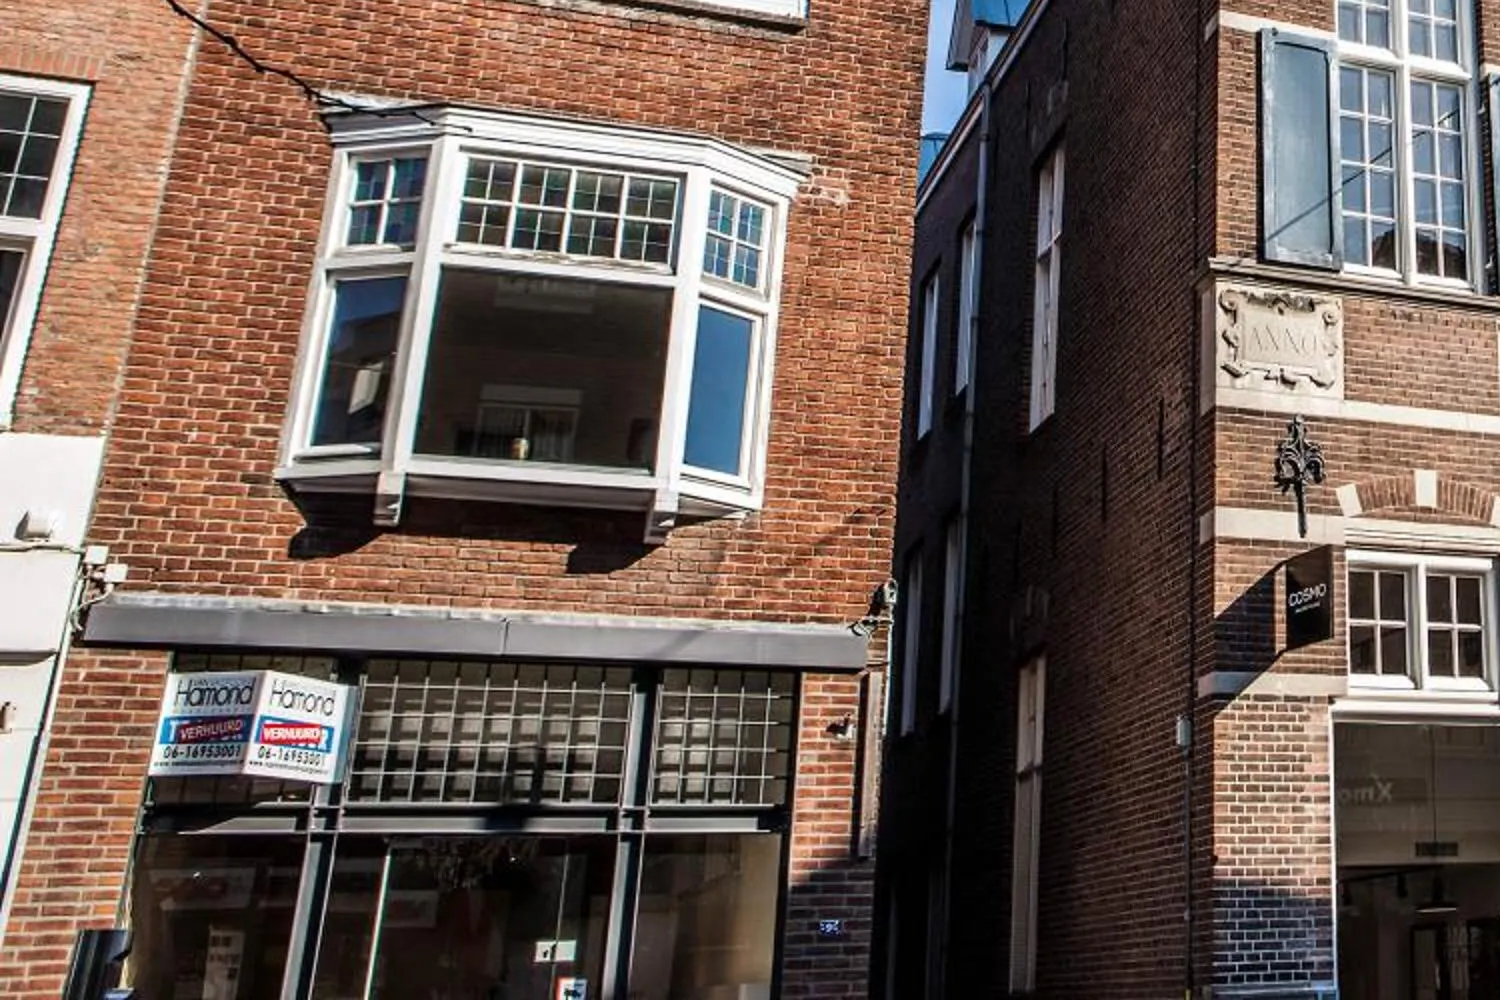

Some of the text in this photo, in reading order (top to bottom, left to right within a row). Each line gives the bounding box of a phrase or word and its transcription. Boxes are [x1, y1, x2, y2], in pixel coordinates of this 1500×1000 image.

[1288, 583, 1327, 607] COSMO
[174, 677, 257, 707] Hamond
[270, 678, 337, 717] Hamond
[179, 719, 244, 741] VERHUURD
[263, 727, 322, 742] VERHUURD
